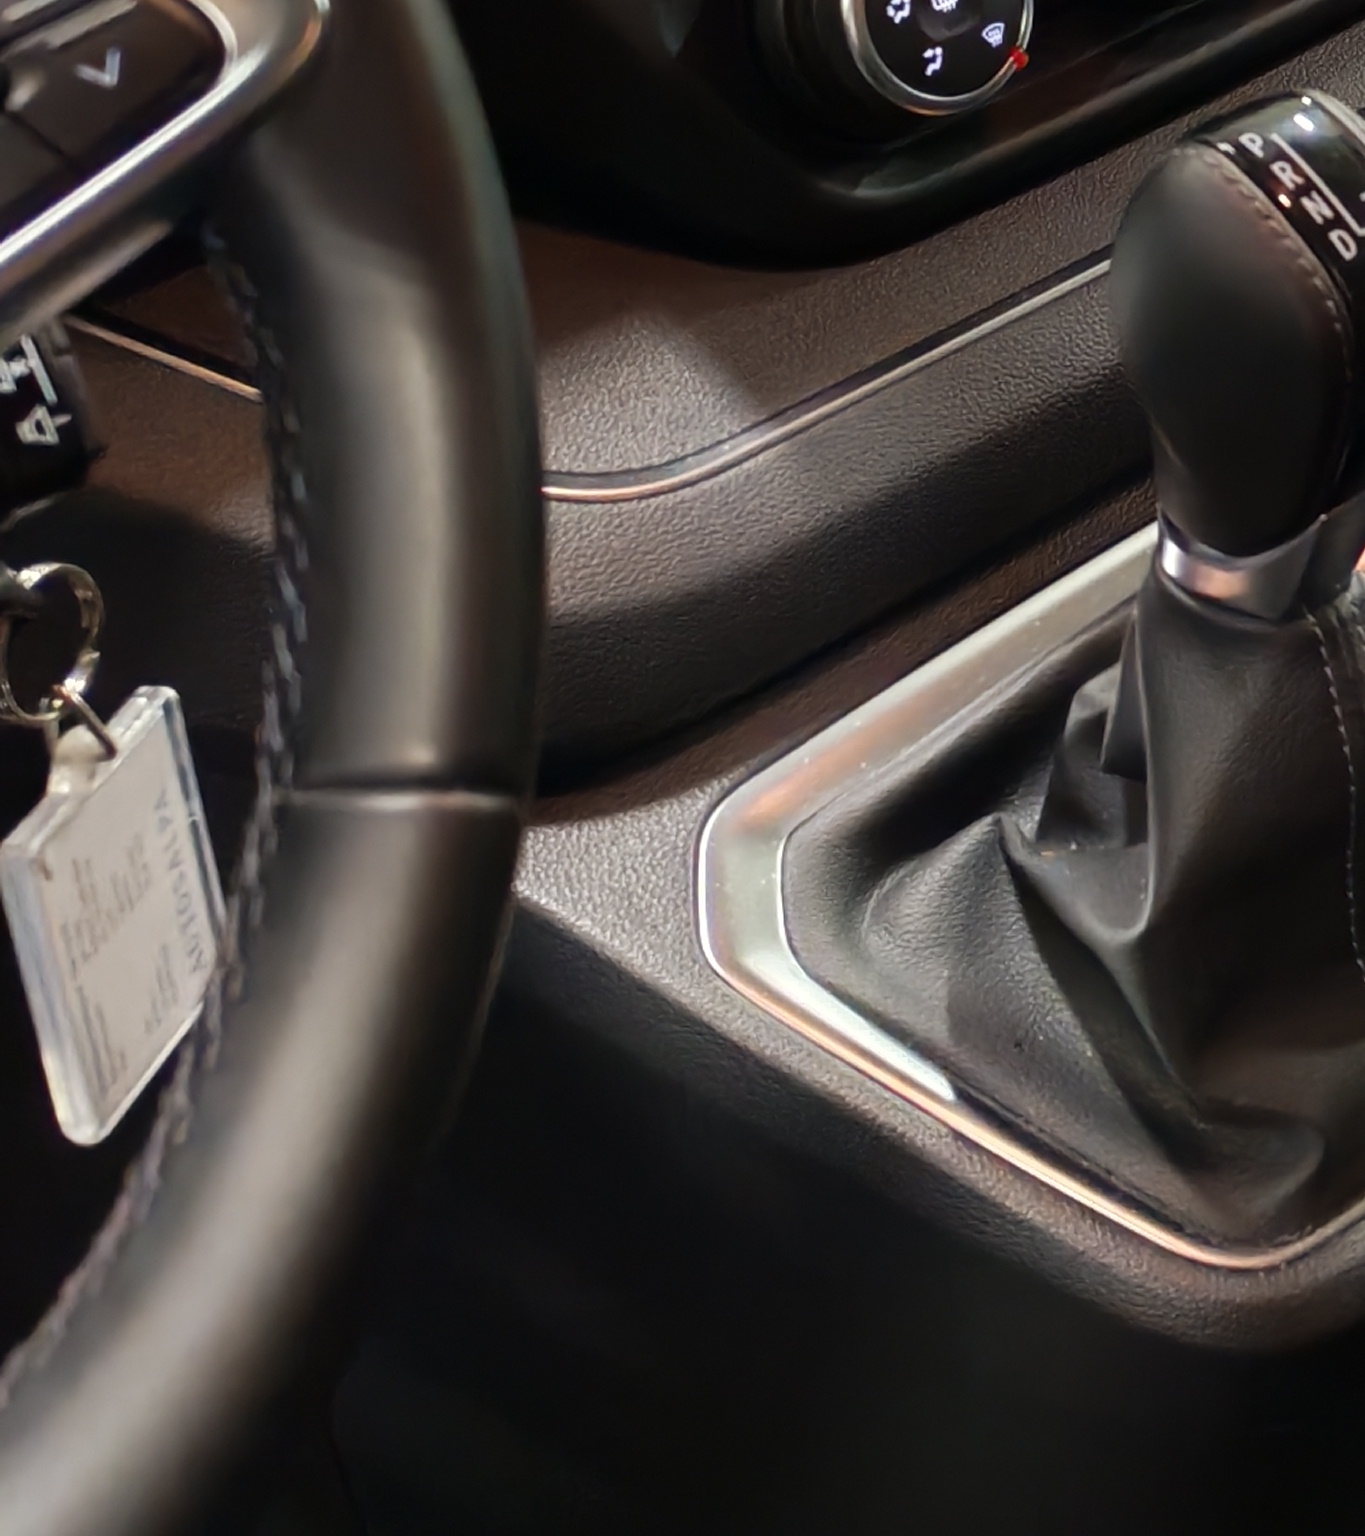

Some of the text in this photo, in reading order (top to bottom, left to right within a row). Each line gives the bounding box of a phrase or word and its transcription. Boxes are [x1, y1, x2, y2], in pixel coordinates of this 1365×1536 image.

[1238, 132, 1358, 261] P R N D
